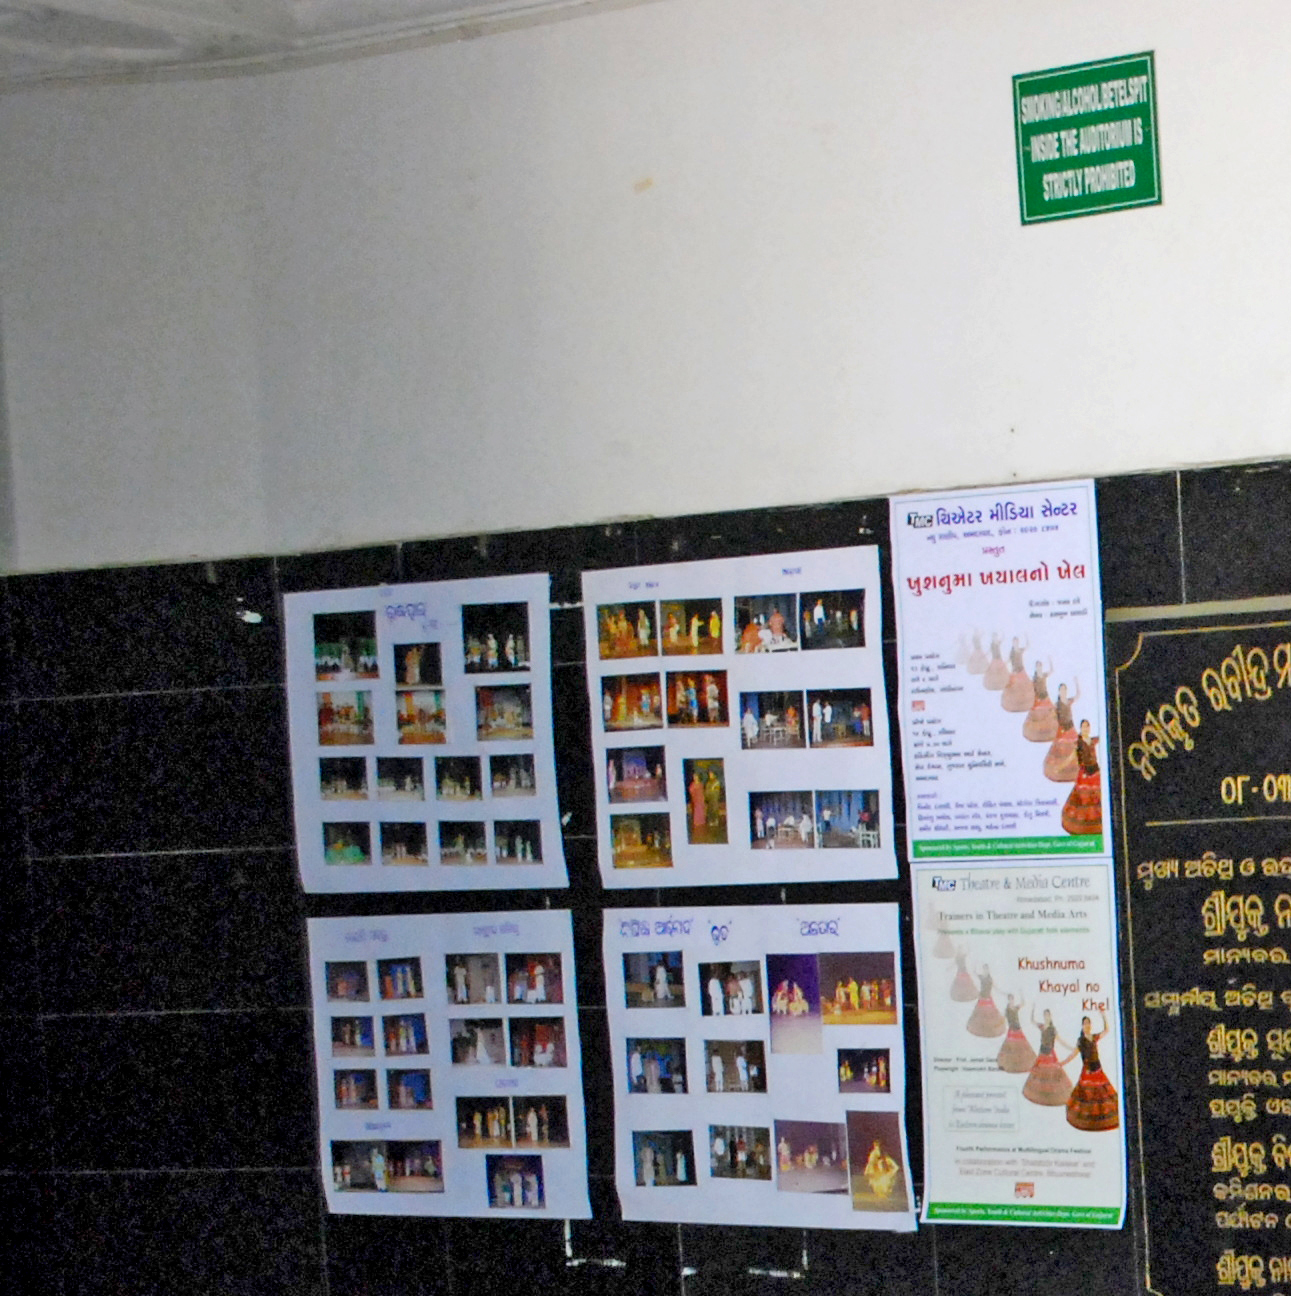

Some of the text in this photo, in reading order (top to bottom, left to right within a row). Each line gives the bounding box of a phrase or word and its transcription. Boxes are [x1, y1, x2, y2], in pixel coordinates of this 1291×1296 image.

[1060, 129, 1078, 157] THE
[1133, 117, 1143, 145] IS
[1043, 159, 1136, 201] STRICTLY PROHIBITED
[1041, 498, 1078, 517] સેન્ટર
[907, 560, 1085, 596] ખુશનુમા ખયાલનો ખેલ
[1240, 858, 1255, 876] ଓ
[960, 872, 1000, 891] Theatre
[1003, 877, 1012, 890] &
[1015, 874, 1049, 890] Media
[1051, 875, 1090, 889] Centre
[975, 911, 984, 921] in
[986, 909, 1017, 920] Theatre
[1019, 909, 1035, 920] and
[1037, 908, 1065, 919] Media
[1067, 908, 1088, 918] Arts
[1018, 957, 1085, 970] Khushnuma
[1039, 979, 1100, 996] Khayal no
[1082, 997, 1109, 1012] Khel
